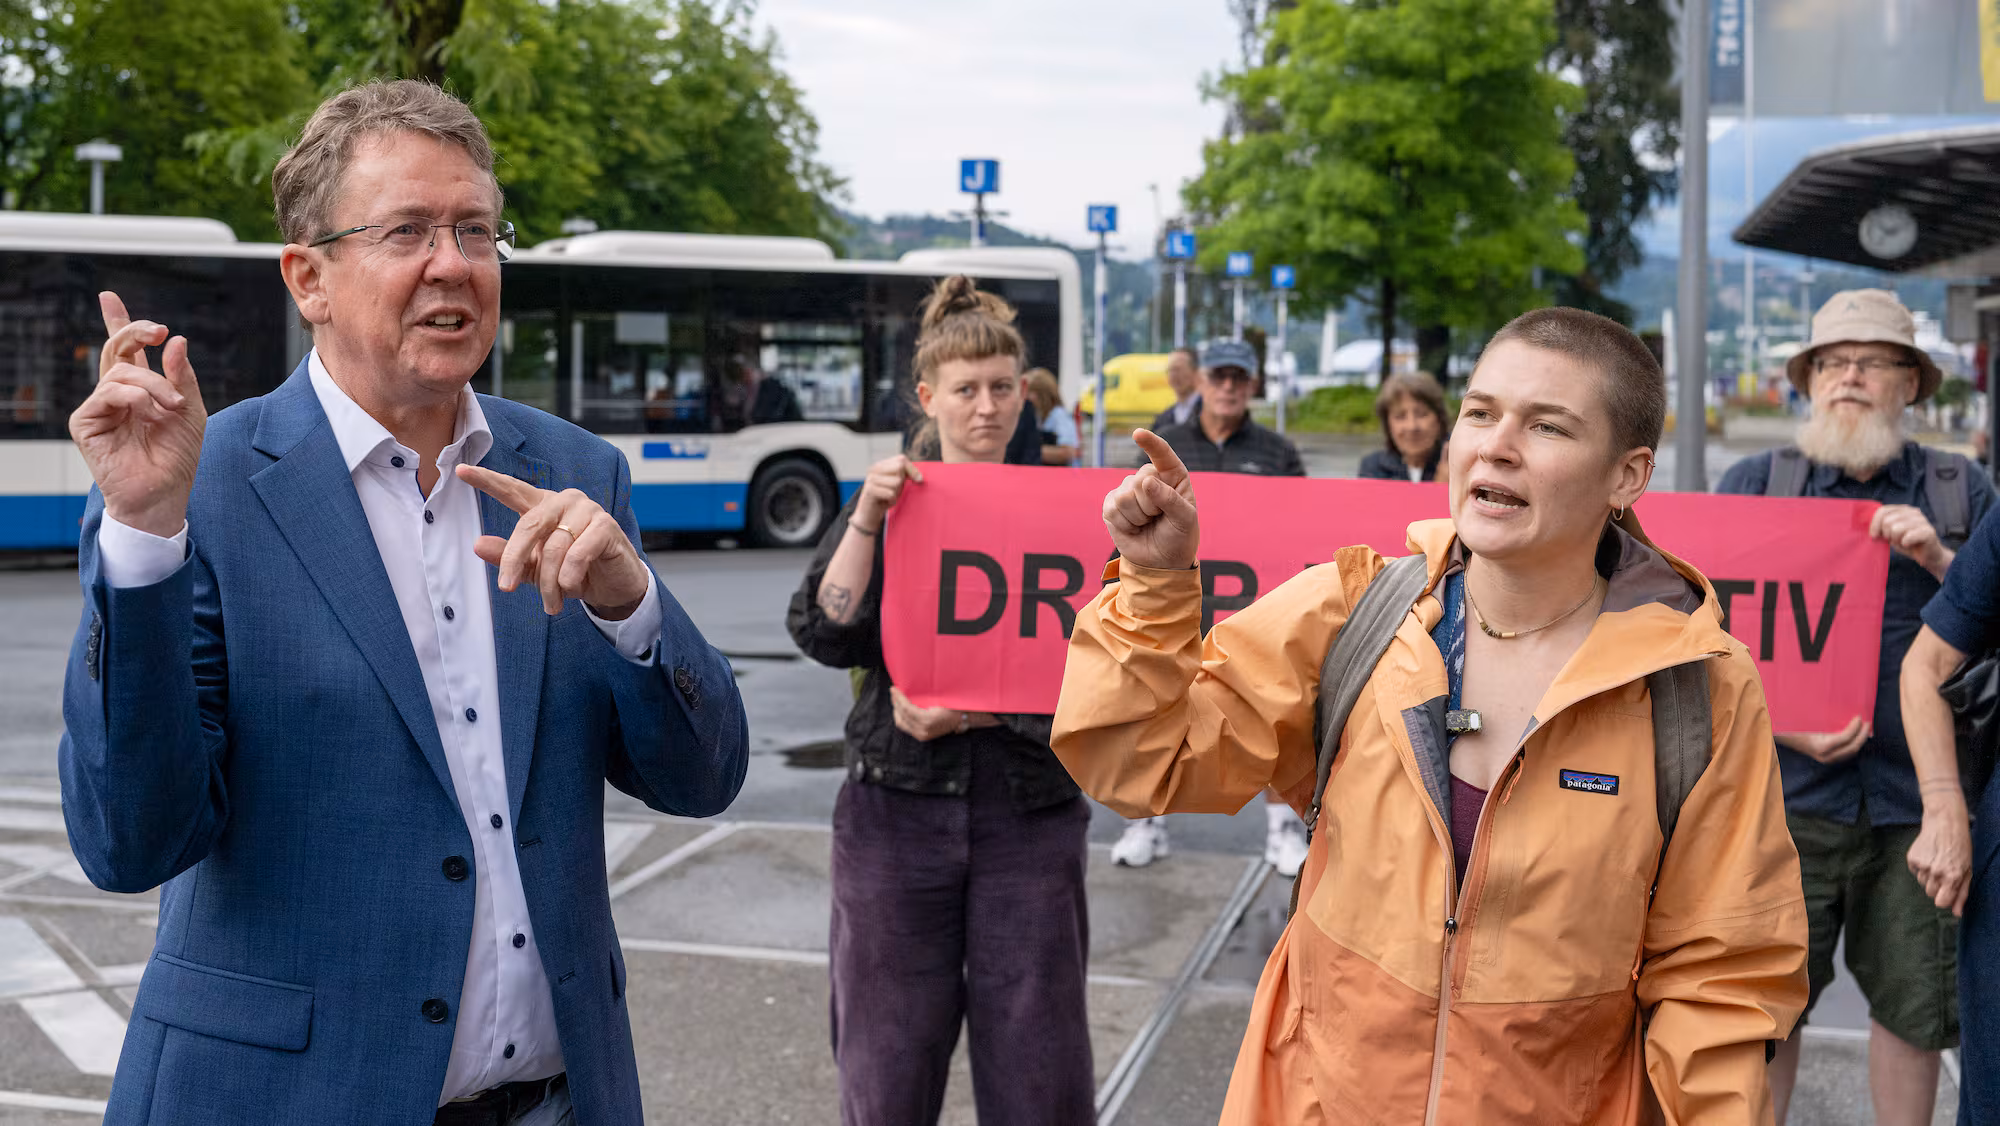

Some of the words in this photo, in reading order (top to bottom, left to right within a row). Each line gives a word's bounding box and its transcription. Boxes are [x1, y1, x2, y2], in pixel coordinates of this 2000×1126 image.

[963, 161, 986, 190] J
[1090, 207, 1108, 230] K
[1172, 234, 1189, 255] L
[937, 549, 1259, 640] DRP
[1567, 780, 1612, 792] patagonia
